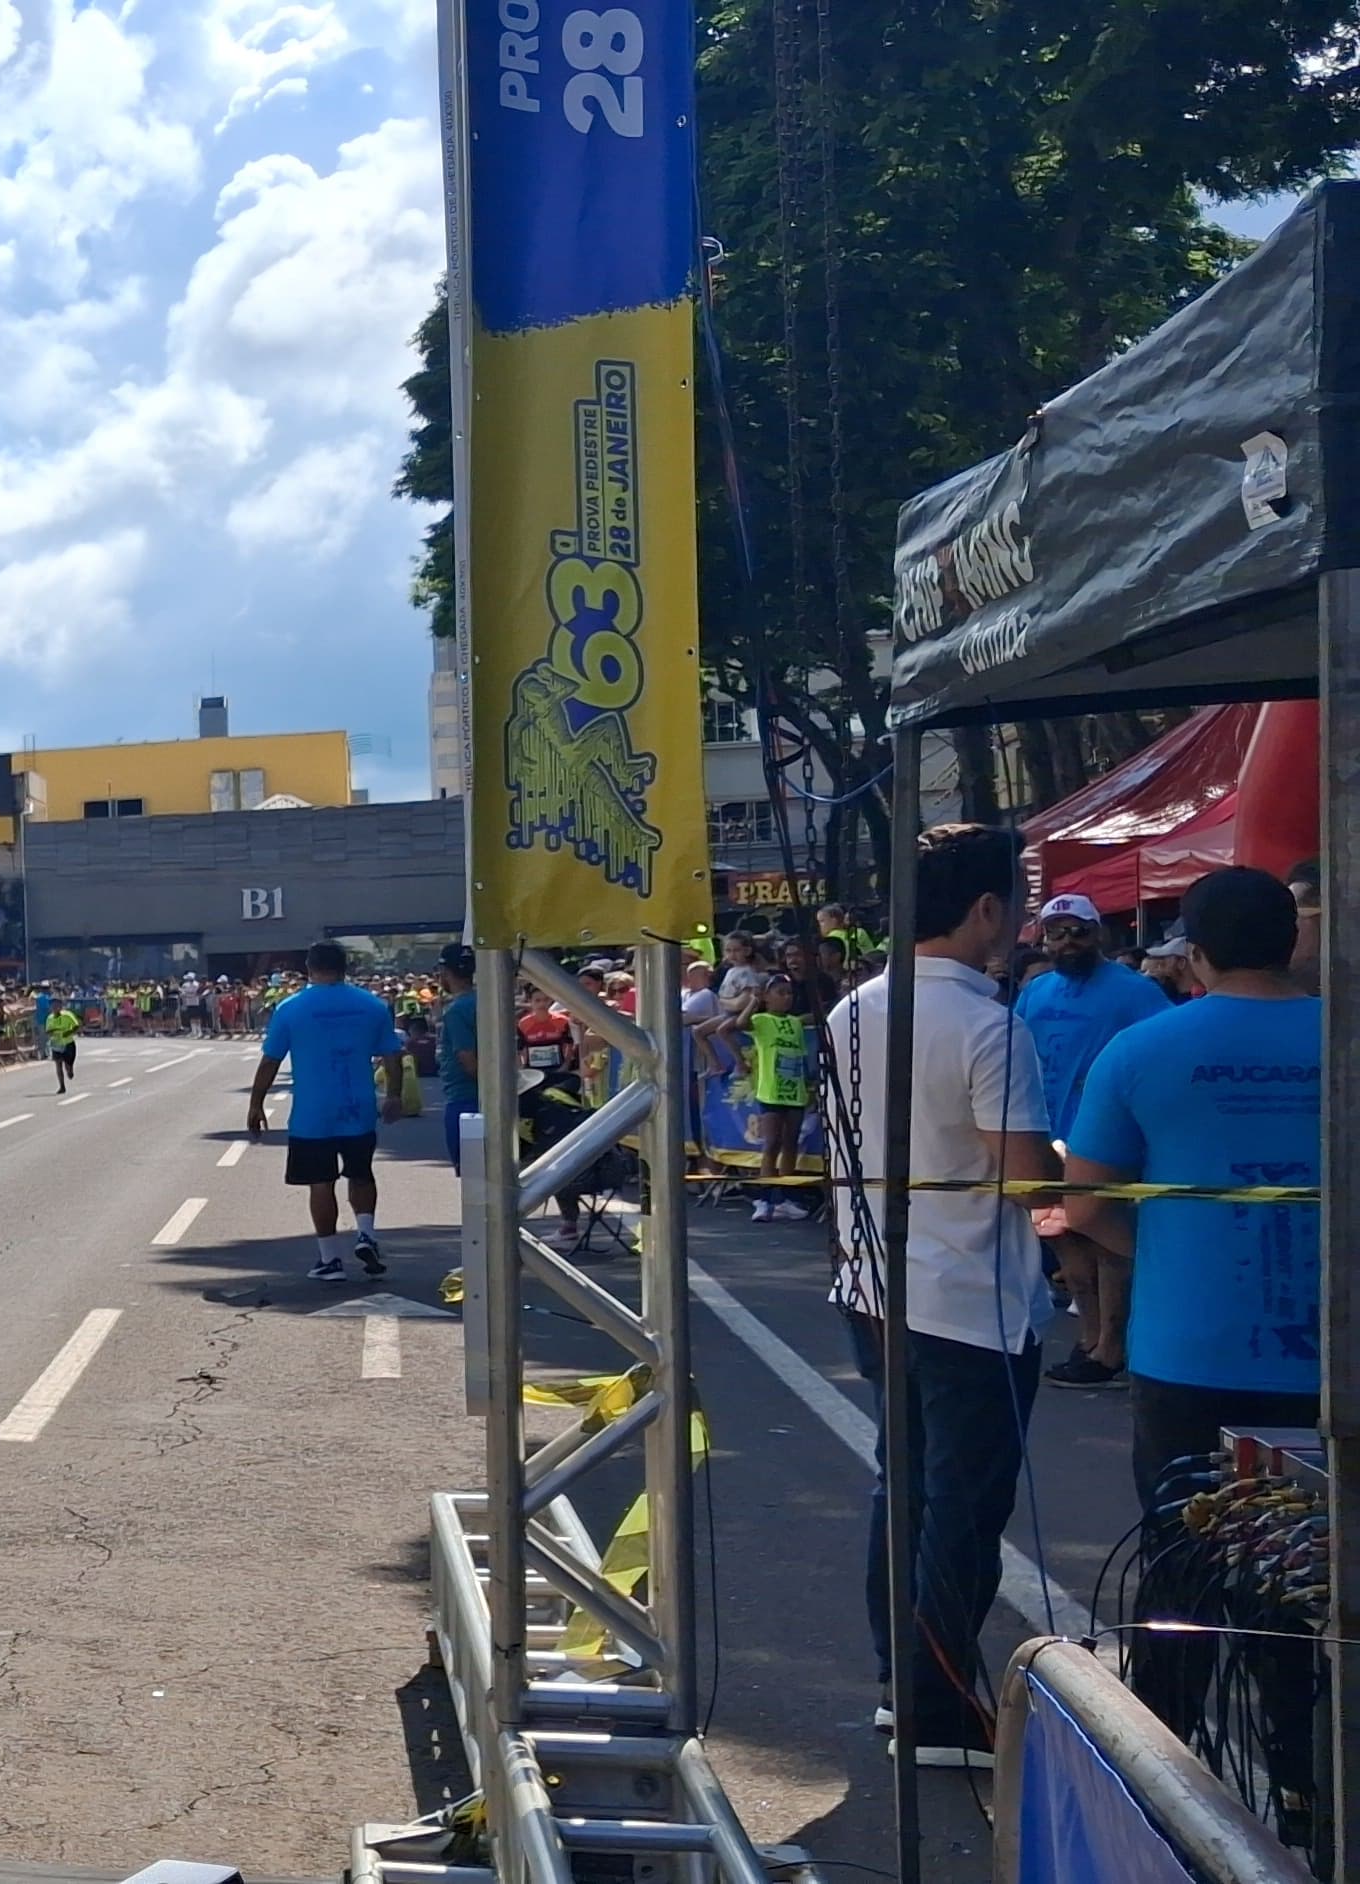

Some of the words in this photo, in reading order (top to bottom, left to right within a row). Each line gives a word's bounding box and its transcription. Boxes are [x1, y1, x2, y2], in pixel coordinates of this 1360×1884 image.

[499, 0, 540, 112] PRO
[562, 8, 644, 137] 28
[583, 407, 601, 493] PEDESTRE
[605, 368, 630, 495] JANEIRO
[586, 495, 601, 553] PROVA
[609, 525, 632, 559] 28
[610, 498, 628, 522] de
[901, 555, 943, 642] CHIP
[240, 886, 286, 920] B1
